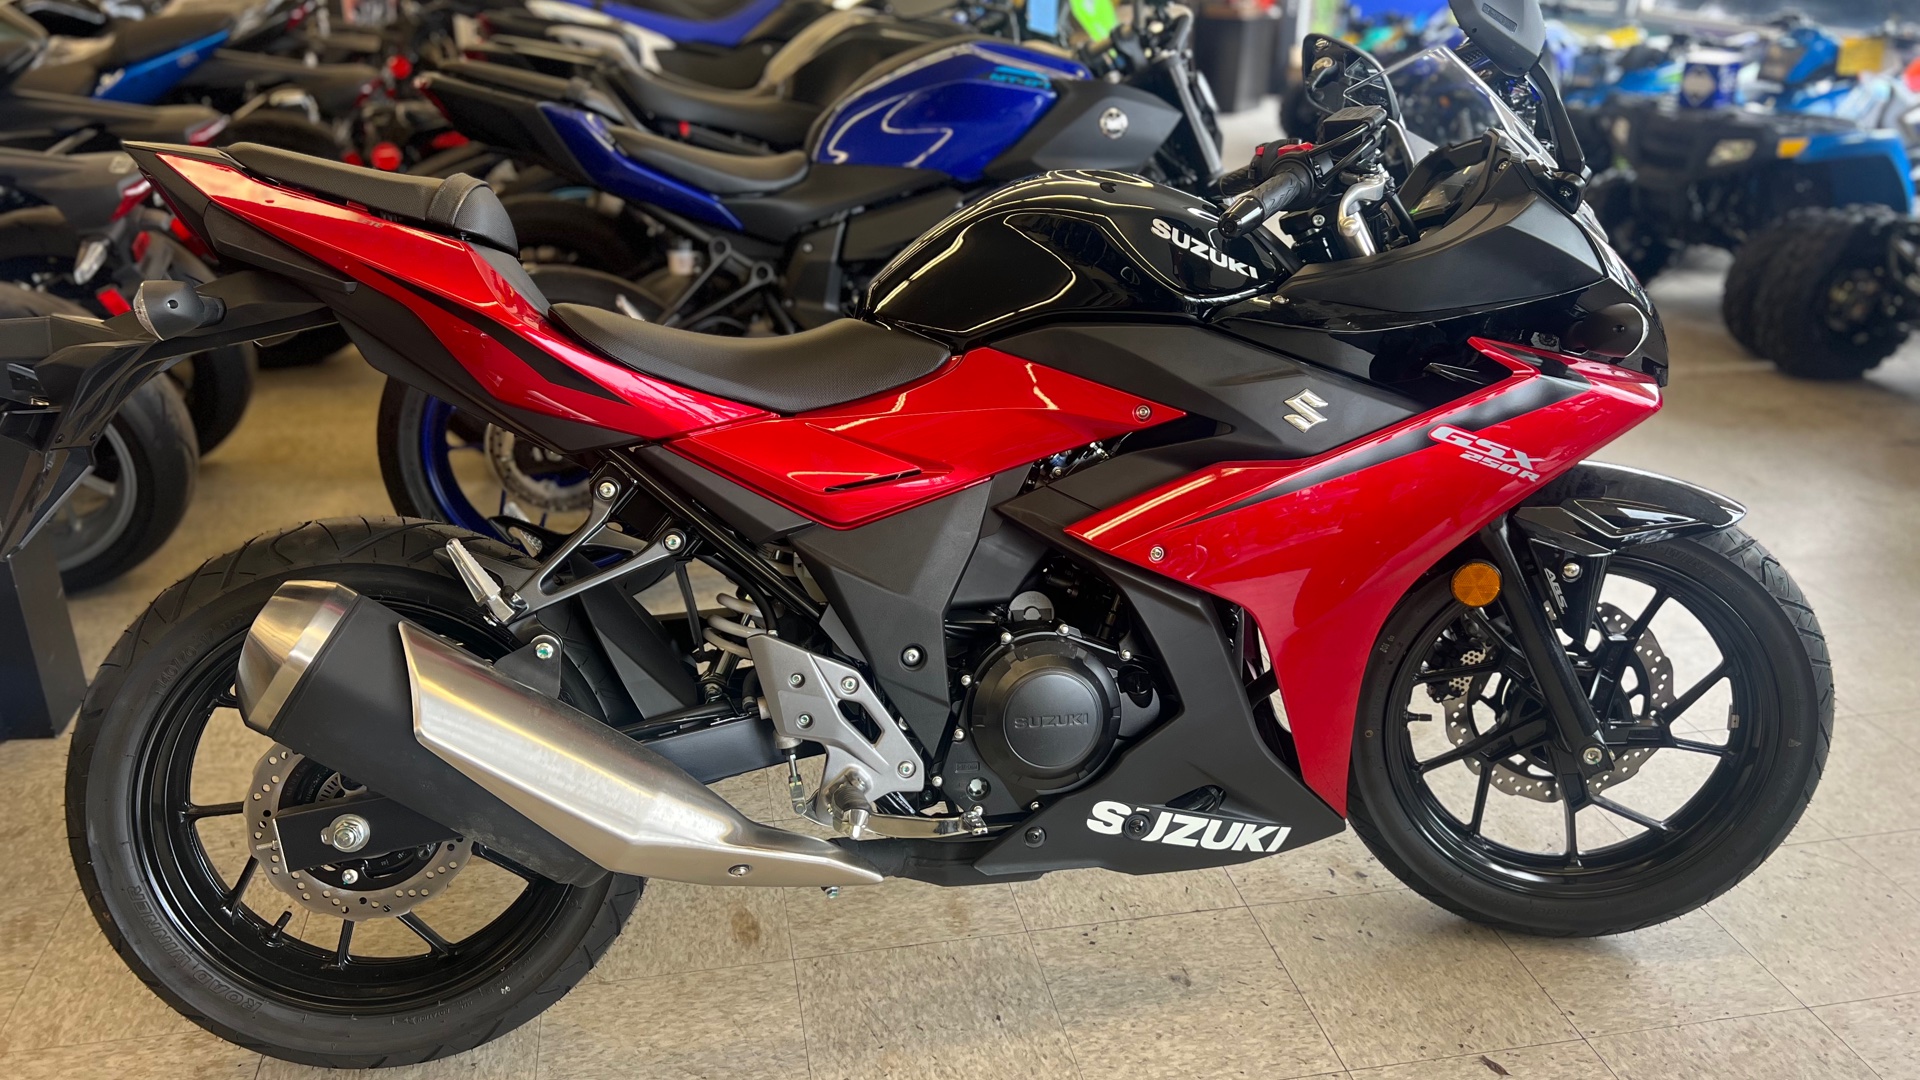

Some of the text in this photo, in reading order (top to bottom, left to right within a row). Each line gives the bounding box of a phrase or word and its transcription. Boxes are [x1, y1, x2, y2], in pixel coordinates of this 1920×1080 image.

[1151, 218, 1259, 280] SUZUKI
[1430, 426, 1546, 471] GSX
[1543, 567, 1568, 615] ABS
[1014, 712, 1089, 729] SUZUKI
[1086, 800, 1292, 852] SUZUKI
[127, 884, 263, 1013] ROAD WINNER
